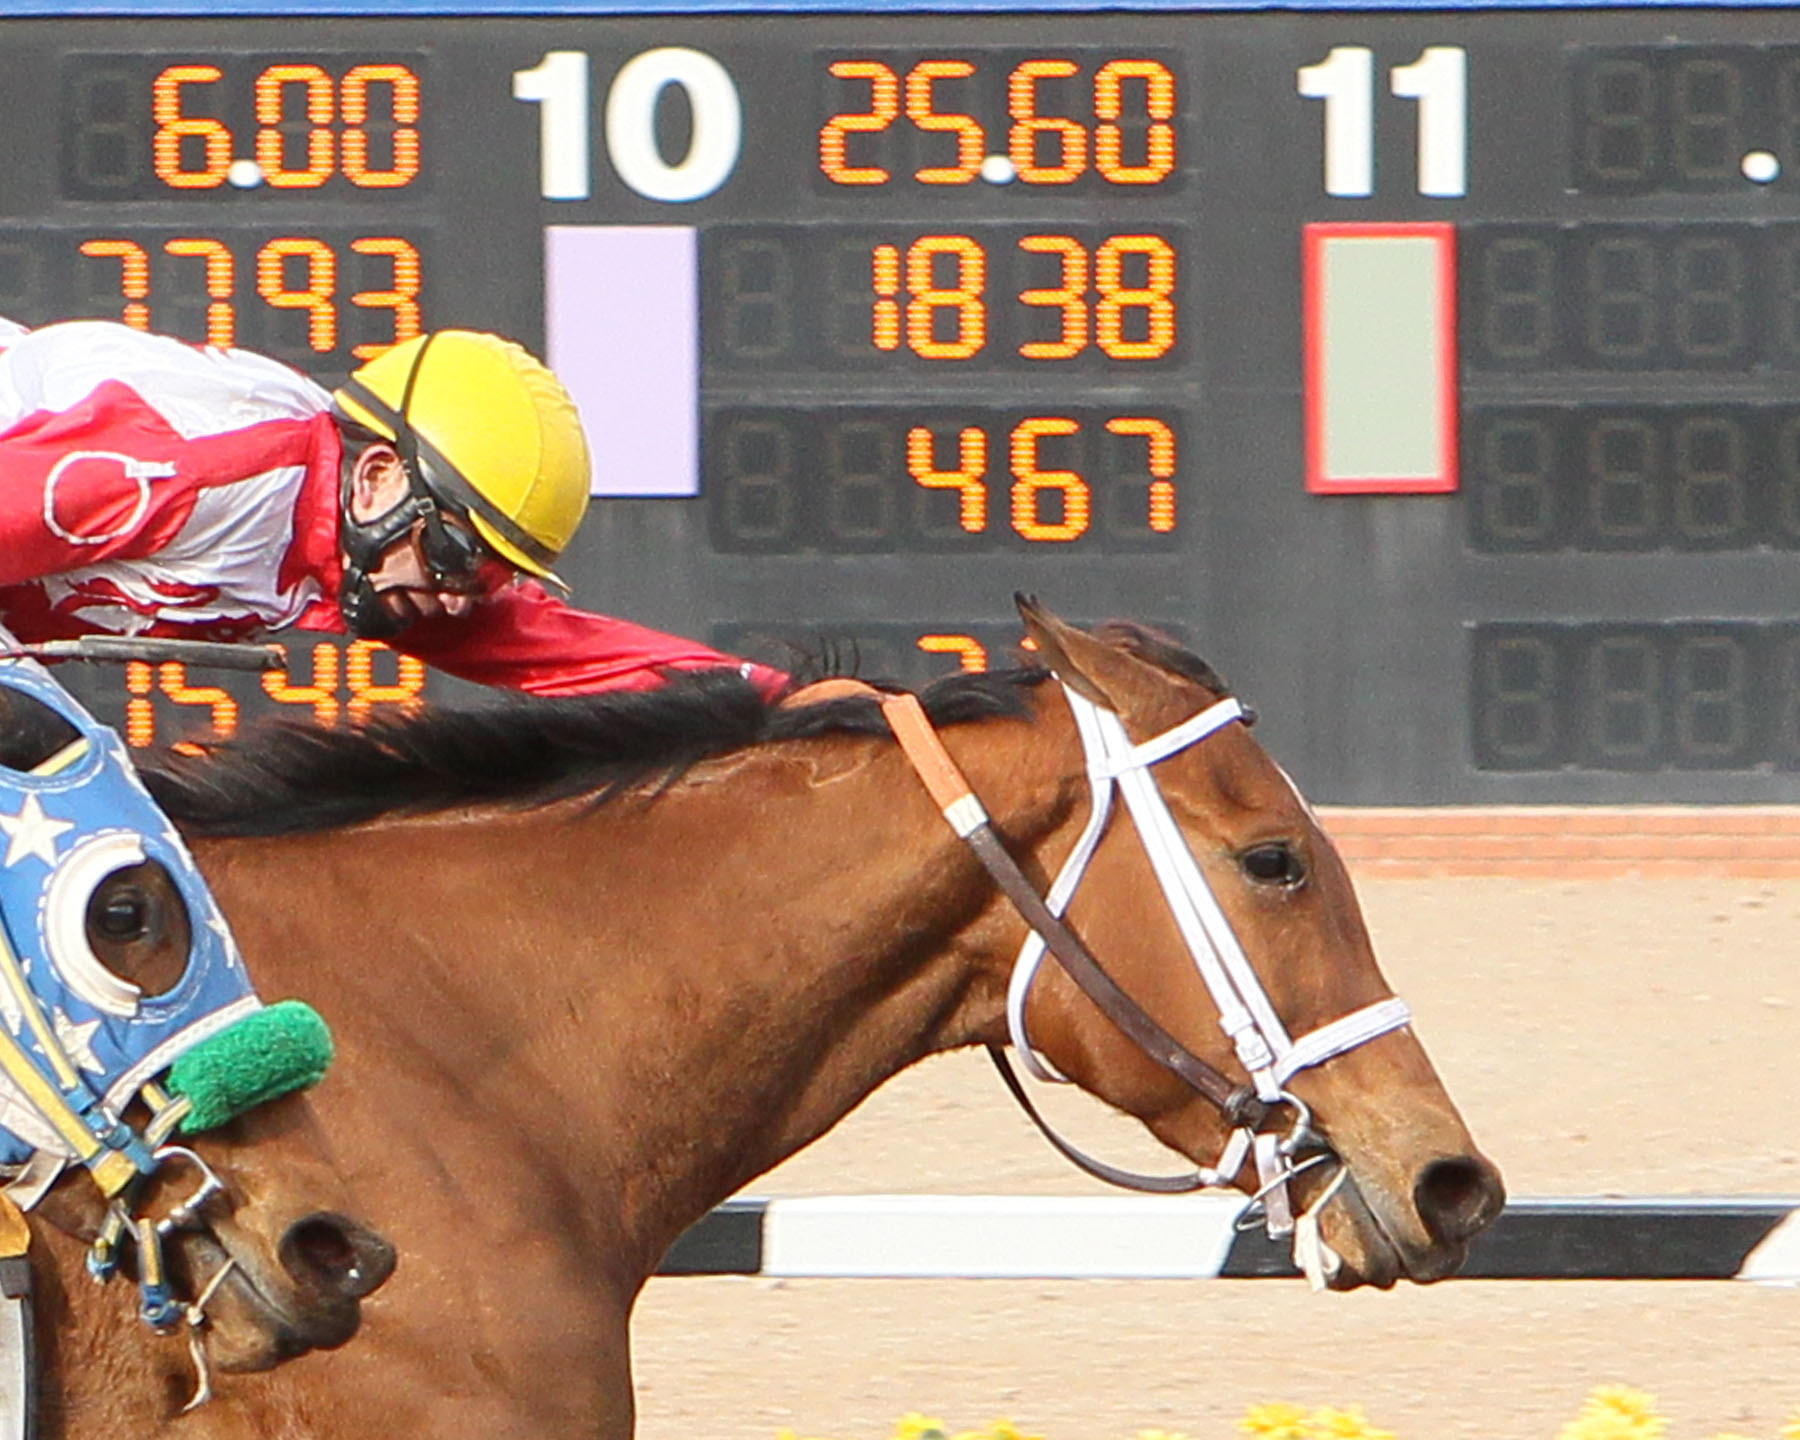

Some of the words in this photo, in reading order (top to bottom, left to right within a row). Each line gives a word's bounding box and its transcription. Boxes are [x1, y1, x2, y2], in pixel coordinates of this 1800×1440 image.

[153, 64, 420, 190] 6.00
[513, 48, 742, 201] 10
[820, 59, 1175, 184] 25.60
[1297, 47, 1467, 197] 11
[81, 238, 421, 359] 7793
[873, 234, 1176, 360] 1838
[906, 417, 1175, 541] 467
